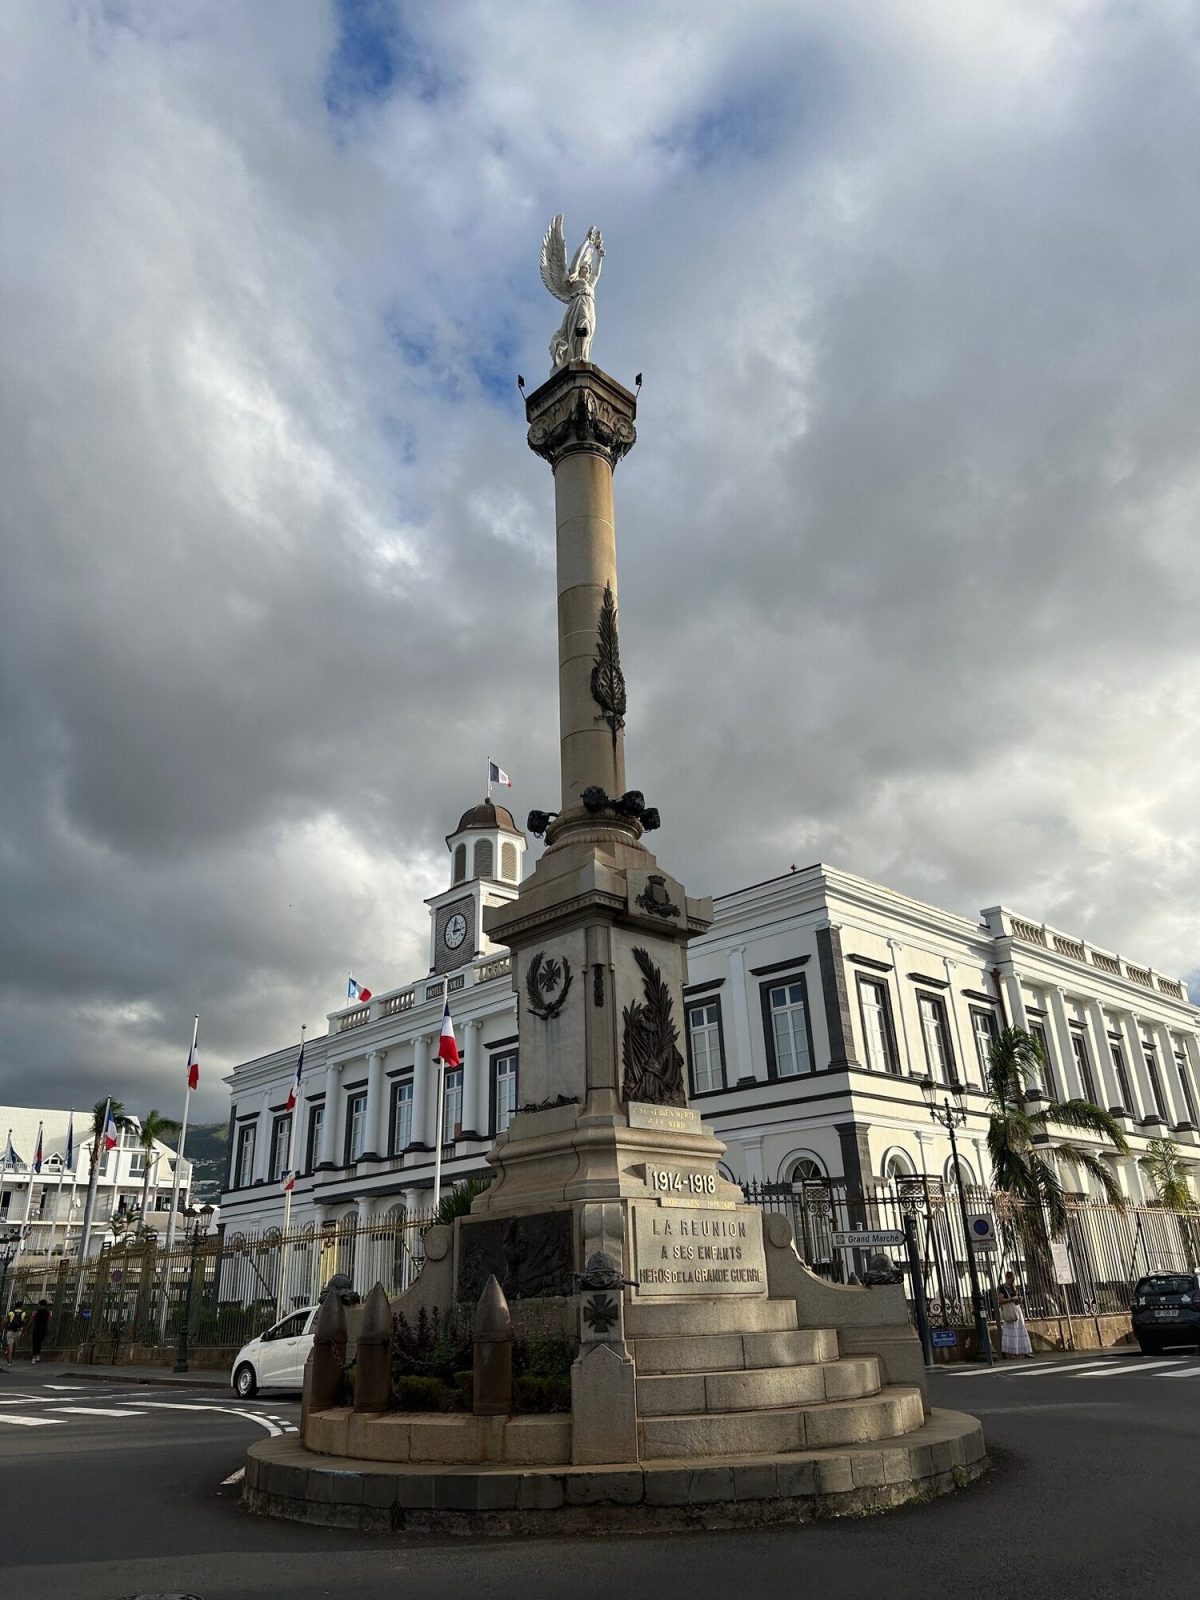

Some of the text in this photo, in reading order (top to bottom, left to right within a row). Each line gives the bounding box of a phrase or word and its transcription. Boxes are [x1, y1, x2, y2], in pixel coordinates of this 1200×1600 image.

[652, 1170, 716, 1194] 1914-1918
[652, 1218, 746, 1237] LA REUNION
[848, 1233, 899, 1244] Grand Marché
[661, 1245, 742, 1261] A SES ENFANTS
[672, 1271, 682, 1283] DE
[683, 1271, 694, 1283] LA
[694, 1268, 729, 1284] GRANDE
[731, 1268, 764, 1284] GUERRE
